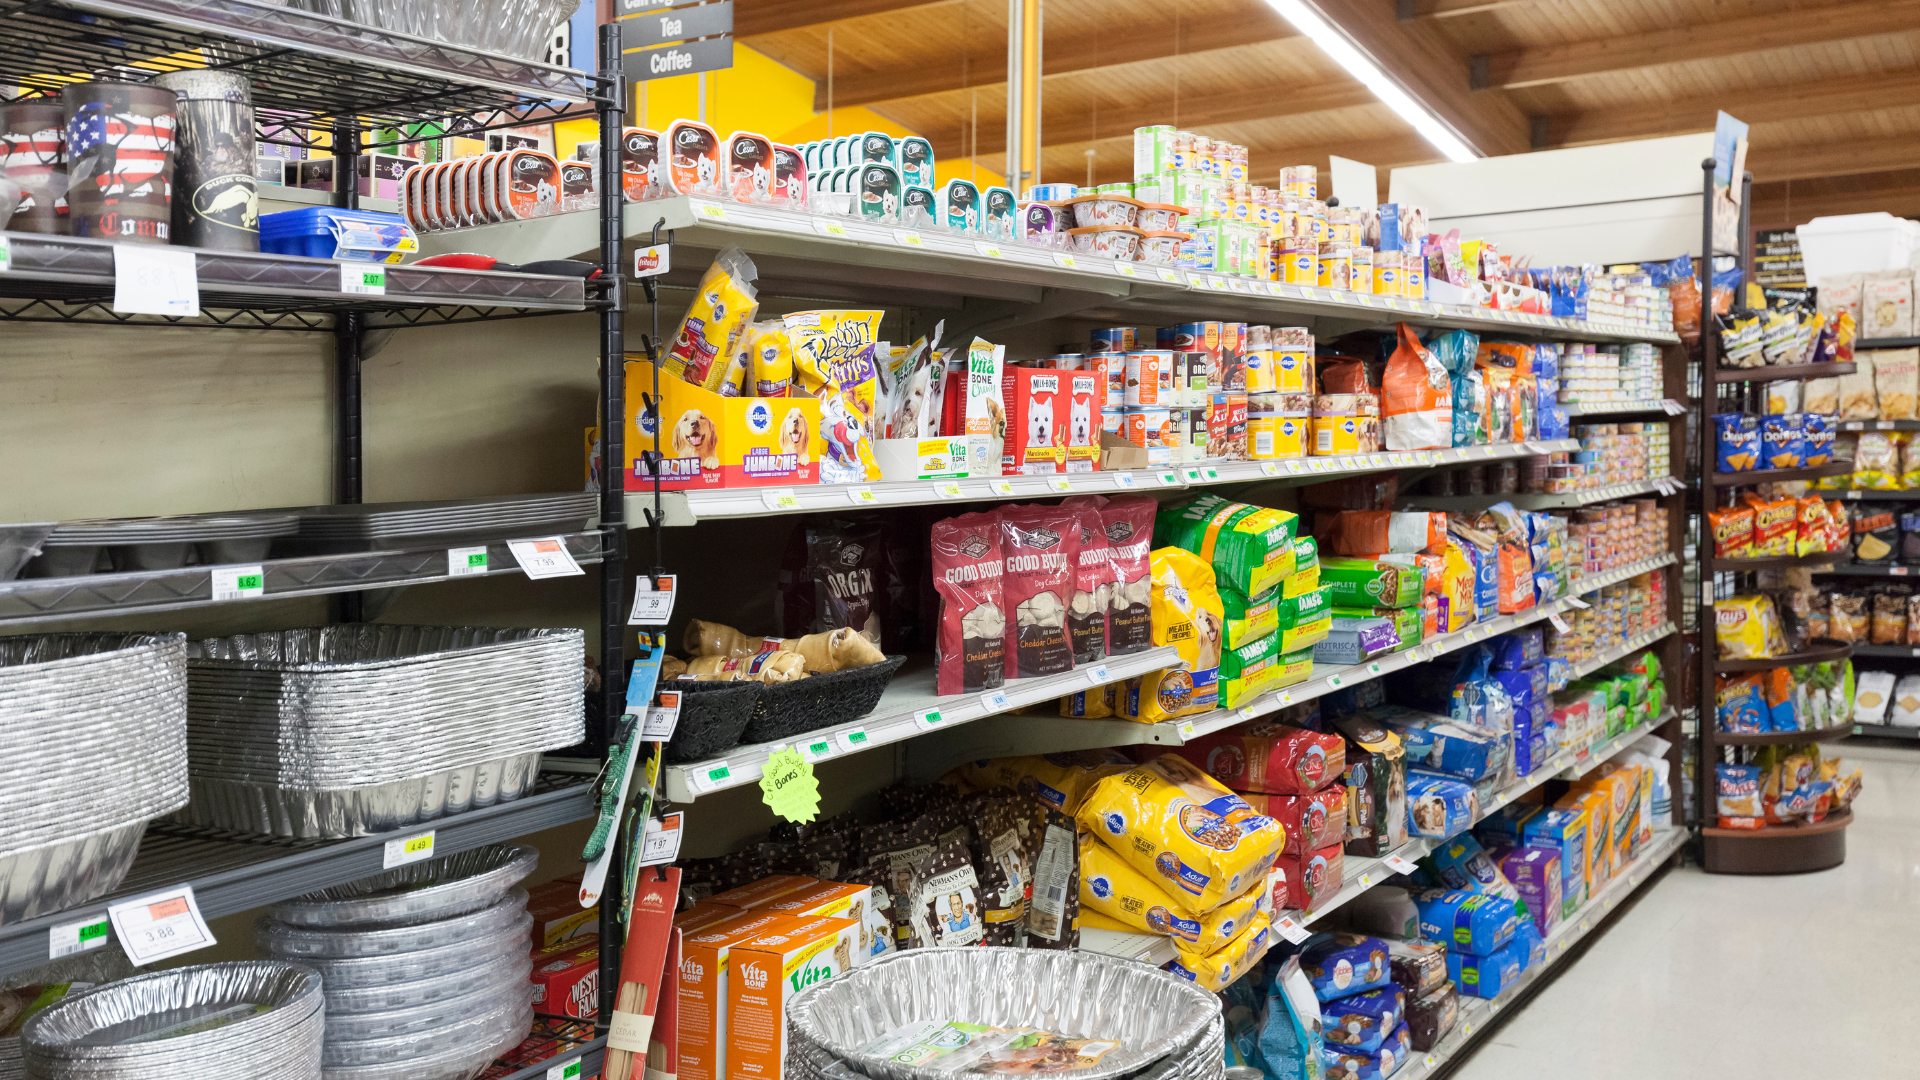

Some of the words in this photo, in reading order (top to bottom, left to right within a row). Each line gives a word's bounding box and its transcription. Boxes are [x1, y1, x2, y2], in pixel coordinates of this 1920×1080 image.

[660, 17, 682, 37] Tea
[651, 50, 692, 74] Coffee
[204, 175, 234, 191] DUCK
[409, 239, 415, 249] 2
[363, 274, 379, 284] 2.07
[971, 349, 995, 375] Vita
[971, 374, 993, 385] BONE
[1033, 379, 1057, 390] MILK-BONE
[745, 412, 774, 422] Pedigree
[751, 447, 770, 456] LARGE
[949, 439, 967, 457] Vita
[744, 453, 798, 473] JUMBONE
[468, 554, 483, 565] 8.39
[1006, 554, 1040, 573] GOOD
[945, 564, 979, 584] GOOD
[978, 559, 1003, 579] BUDD
[237, 575, 257, 588] 8.62
[1034, 579, 1045, 589] Dog
[1320, 580, 1357, 589] COMPLETE
[1115, 617, 1131, 627] Peanut
[1130, 615, 1145, 626] Butter
[1048, 628, 1061, 636] Natural
[1073, 627, 1091, 637] Peanut
[1168, 622, 1193, 634] MEATIER
[1171, 630, 1192, 640] RECIPE!
[1020, 638, 1045, 649] Cheddar
[1045, 636, 1063, 647] Cheese
[1314, 642, 1358, 651] NUTRISCA
[966, 652, 988, 663] Cheddar
[1408, 734, 1424, 744] Pals
[774, 768, 798, 790] Bones
[1358, 787, 1367, 804] True
[1359, 808, 1367, 825] Pals
[410, 840, 427, 852] 4.49
[653, 839, 667, 851] 1.97
[890, 849, 912, 862] MAN'S
[928, 869, 958, 890] NEWMAN'S
[1184, 870, 1205, 884] Adult
[691, 884, 710, 897] NEW
[1121, 895, 1144, 908] MEATIER
[79, 923, 101, 939] 4.08
[1177, 920, 1196, 931] Adult
[1420, 921, 1442, 935] CAT
[145, 926, 176, 943] 3.88
[679, 955, 704, 976] Vita
[741, 960, 768, 982] Vita
[790, 951, 832, 993] Vita
[682, 973, 703, 983] BONE
[744, 979, 767, 988] BONE
[570, 968, 600, 1004] WEST
[577, 988, 600, 1018] FAM
[615, 1026, 638, 1038] CEDAR
[563, 1066, 578, 1080] 2.29
